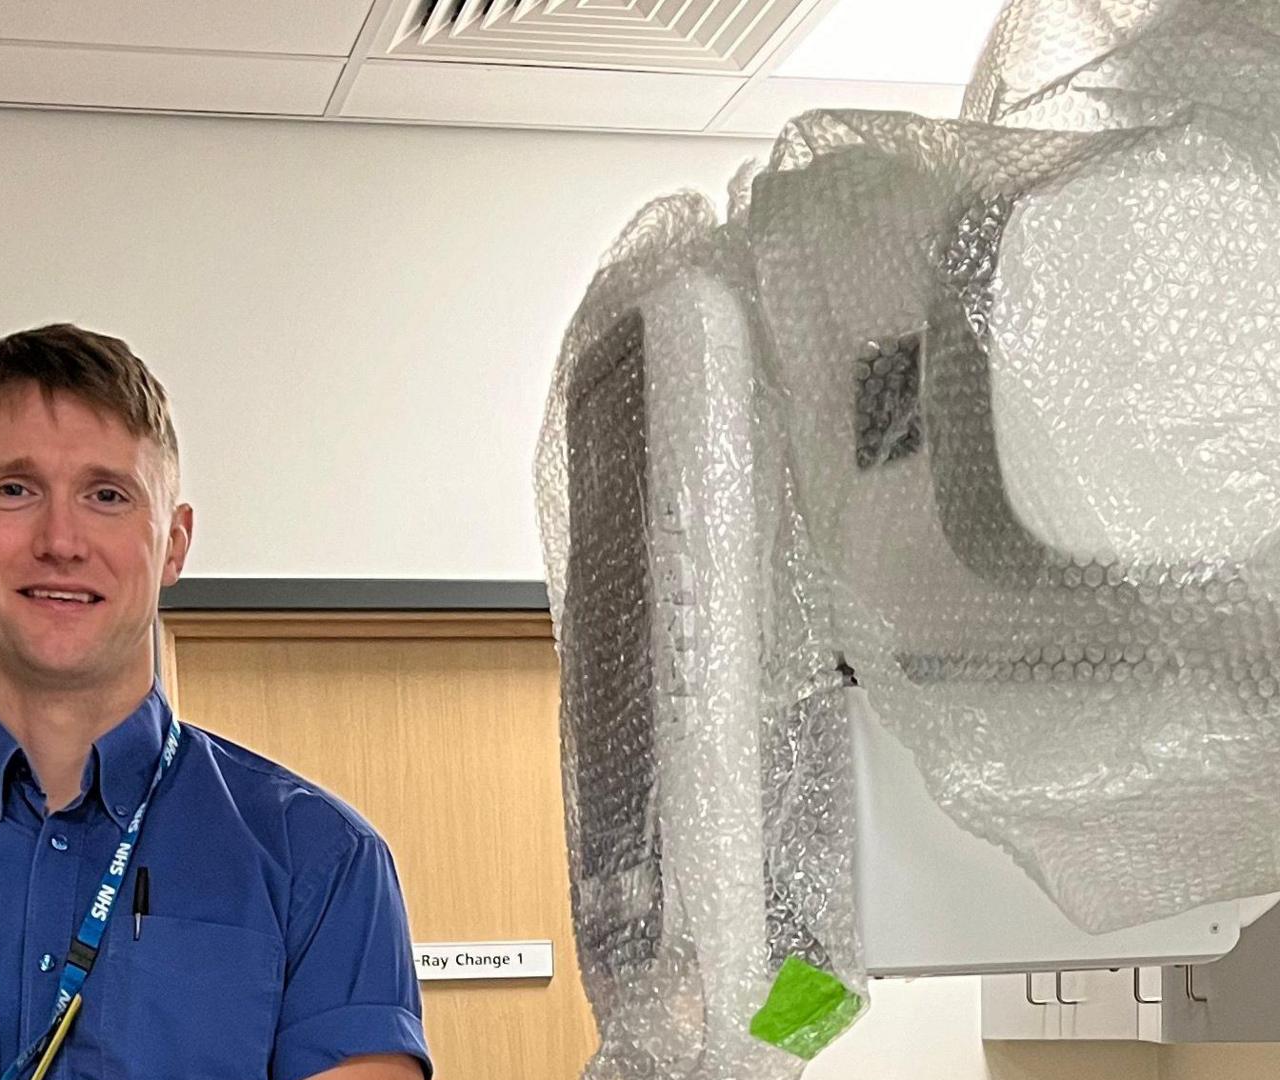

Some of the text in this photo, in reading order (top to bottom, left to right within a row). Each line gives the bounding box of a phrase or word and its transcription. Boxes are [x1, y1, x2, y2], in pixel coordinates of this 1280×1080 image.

[110, 843, 132, 876] NHS
[91, 884, 116, 922] NHS
[415, 953, 524, 970] -Ray Change 1
